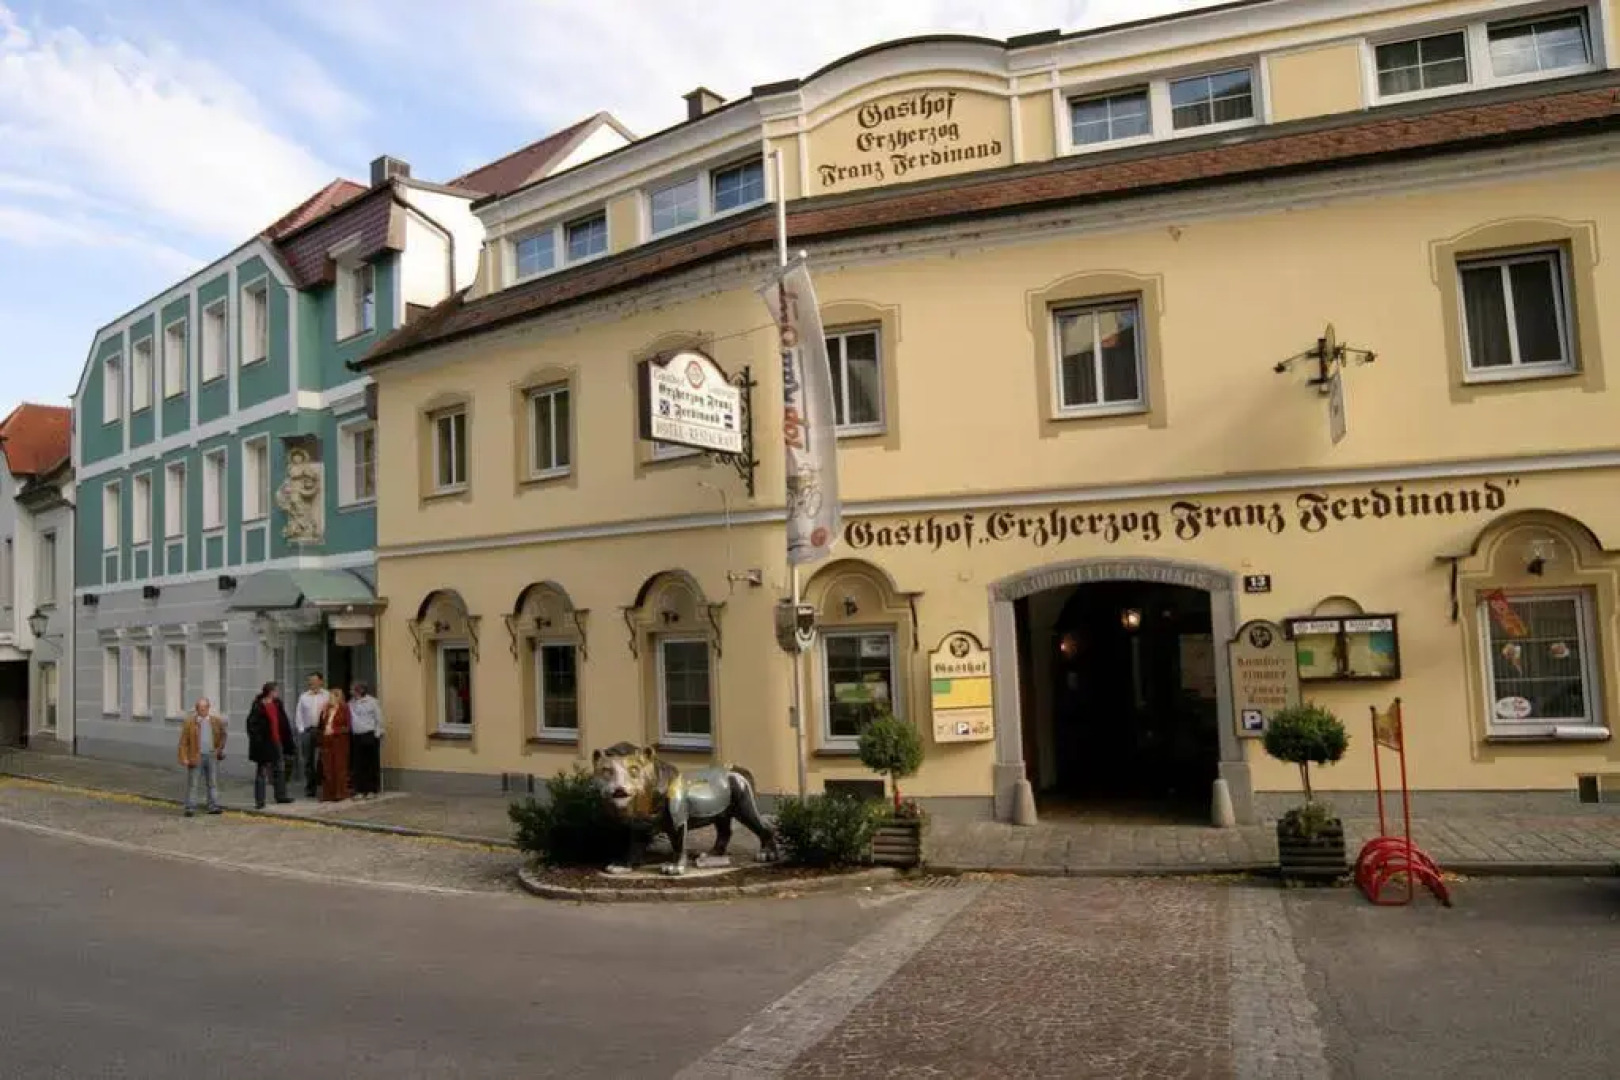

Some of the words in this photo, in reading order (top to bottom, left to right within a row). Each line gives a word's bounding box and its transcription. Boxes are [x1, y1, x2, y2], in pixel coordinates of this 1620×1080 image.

[858, 91, 957, 128] Gasthof
[856, 122, 960, 152] Erzherzog
[818, 161, 885, 187] Franz
[891, 140, 1001, 176] Ferdinand
[844, 514, 975, 550] Gasthof
[1170, 501, 1285, 540] Franz
[934, 660, 987, 674] Gasthof
